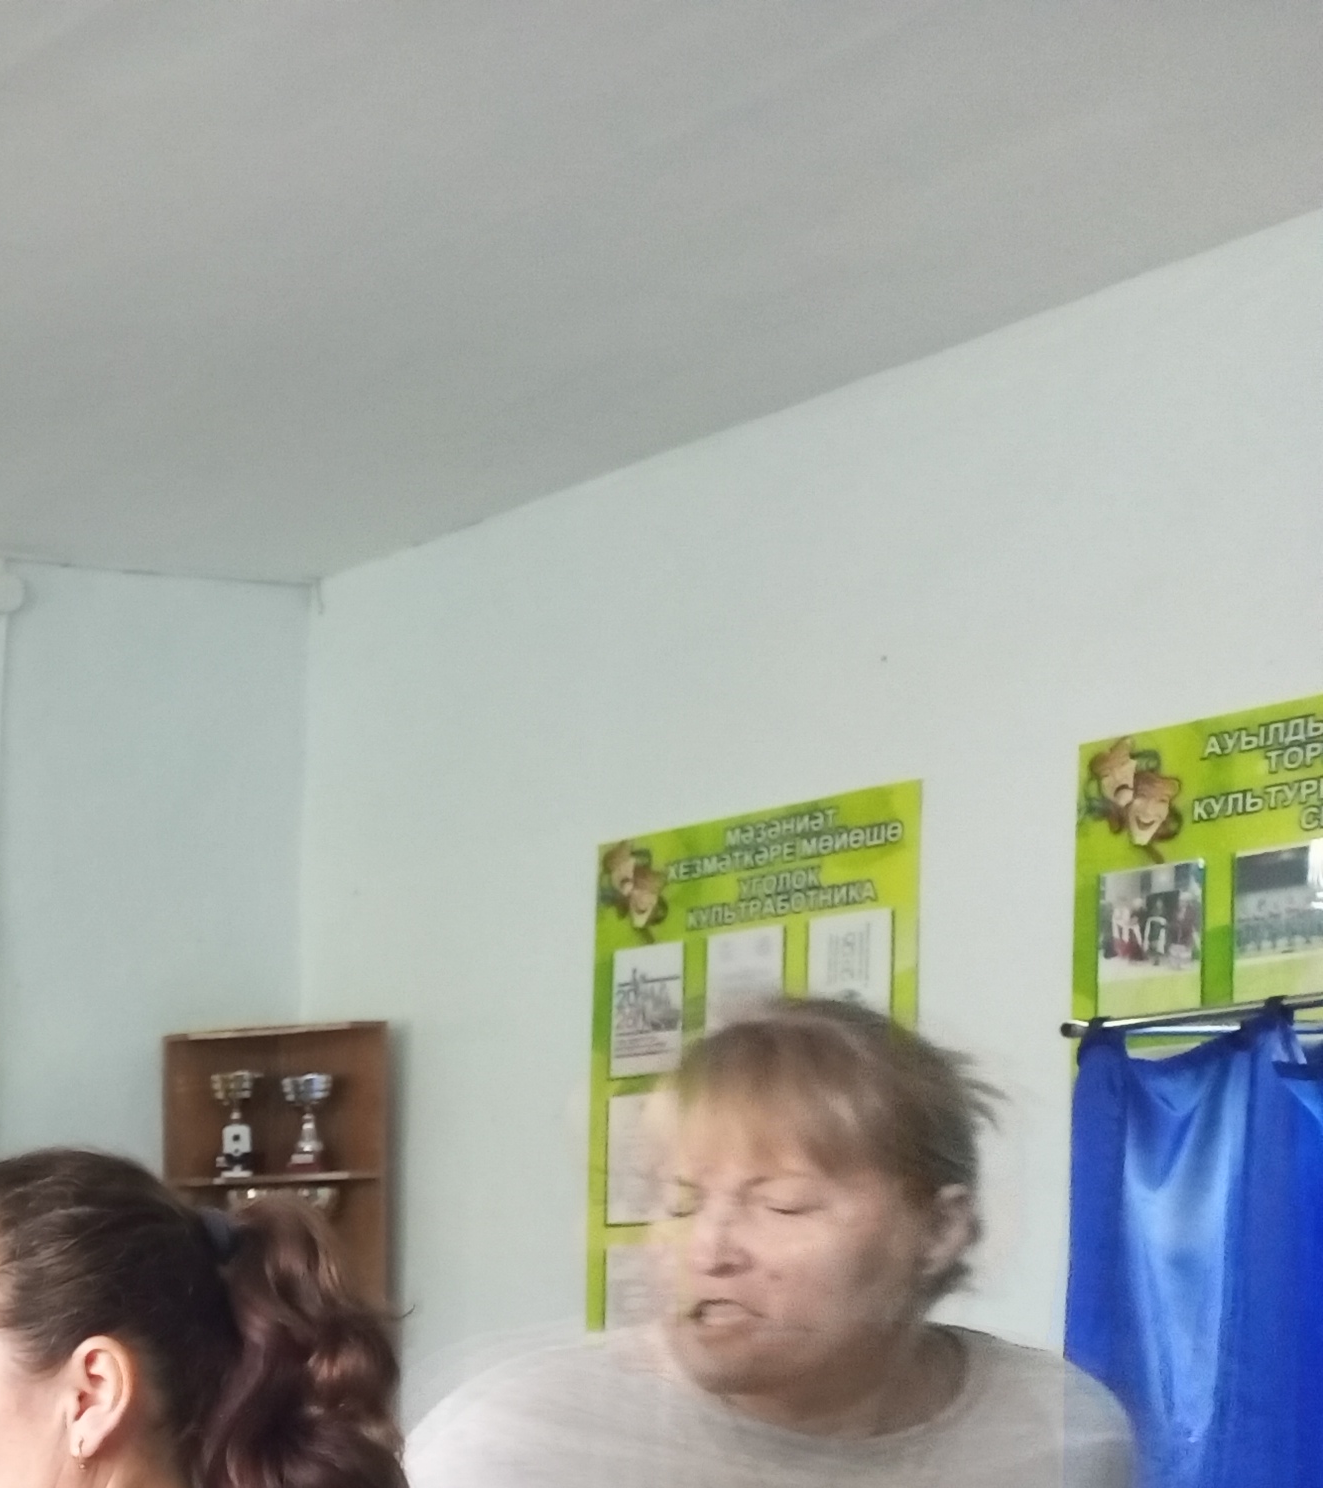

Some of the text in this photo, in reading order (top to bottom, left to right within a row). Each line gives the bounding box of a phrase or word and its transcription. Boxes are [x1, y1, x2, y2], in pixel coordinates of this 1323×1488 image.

[1194, 778, 1323, 820] КУЛЬТУР
[737, 867, 821, 897] УГОЛОК
[685, 880, 877, 931] КУЛЬТРАБОТНИКА
